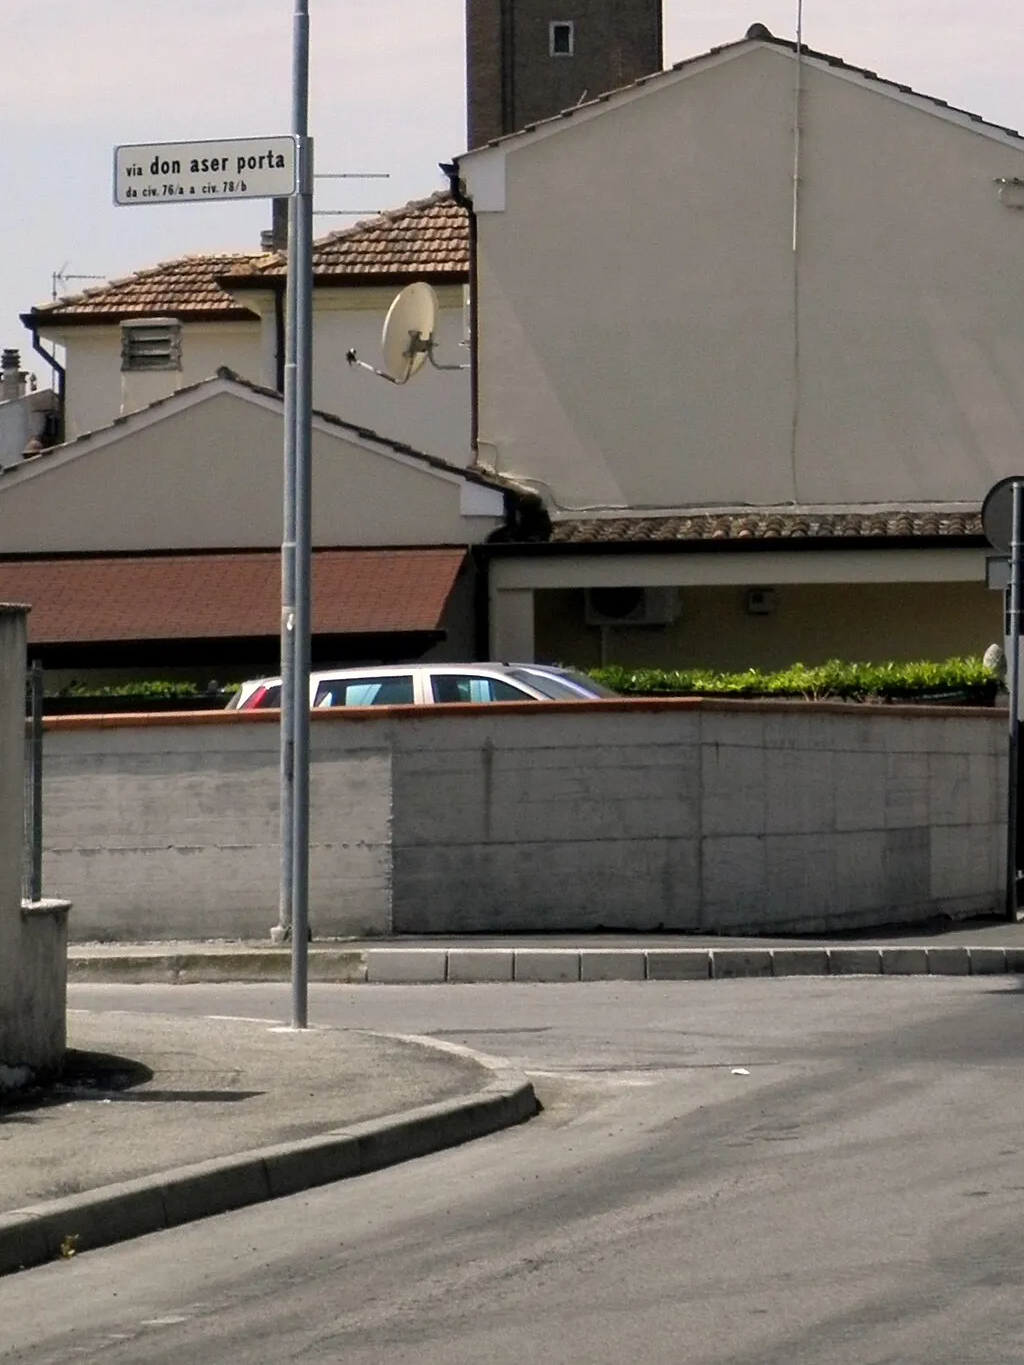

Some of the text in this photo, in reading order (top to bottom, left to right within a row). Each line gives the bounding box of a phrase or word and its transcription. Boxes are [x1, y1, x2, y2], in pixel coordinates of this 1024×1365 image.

[126, 150, 285, 177] via don aser porta
[126, 180, 247, 198] da civ. 76/a a civ. 78/b
